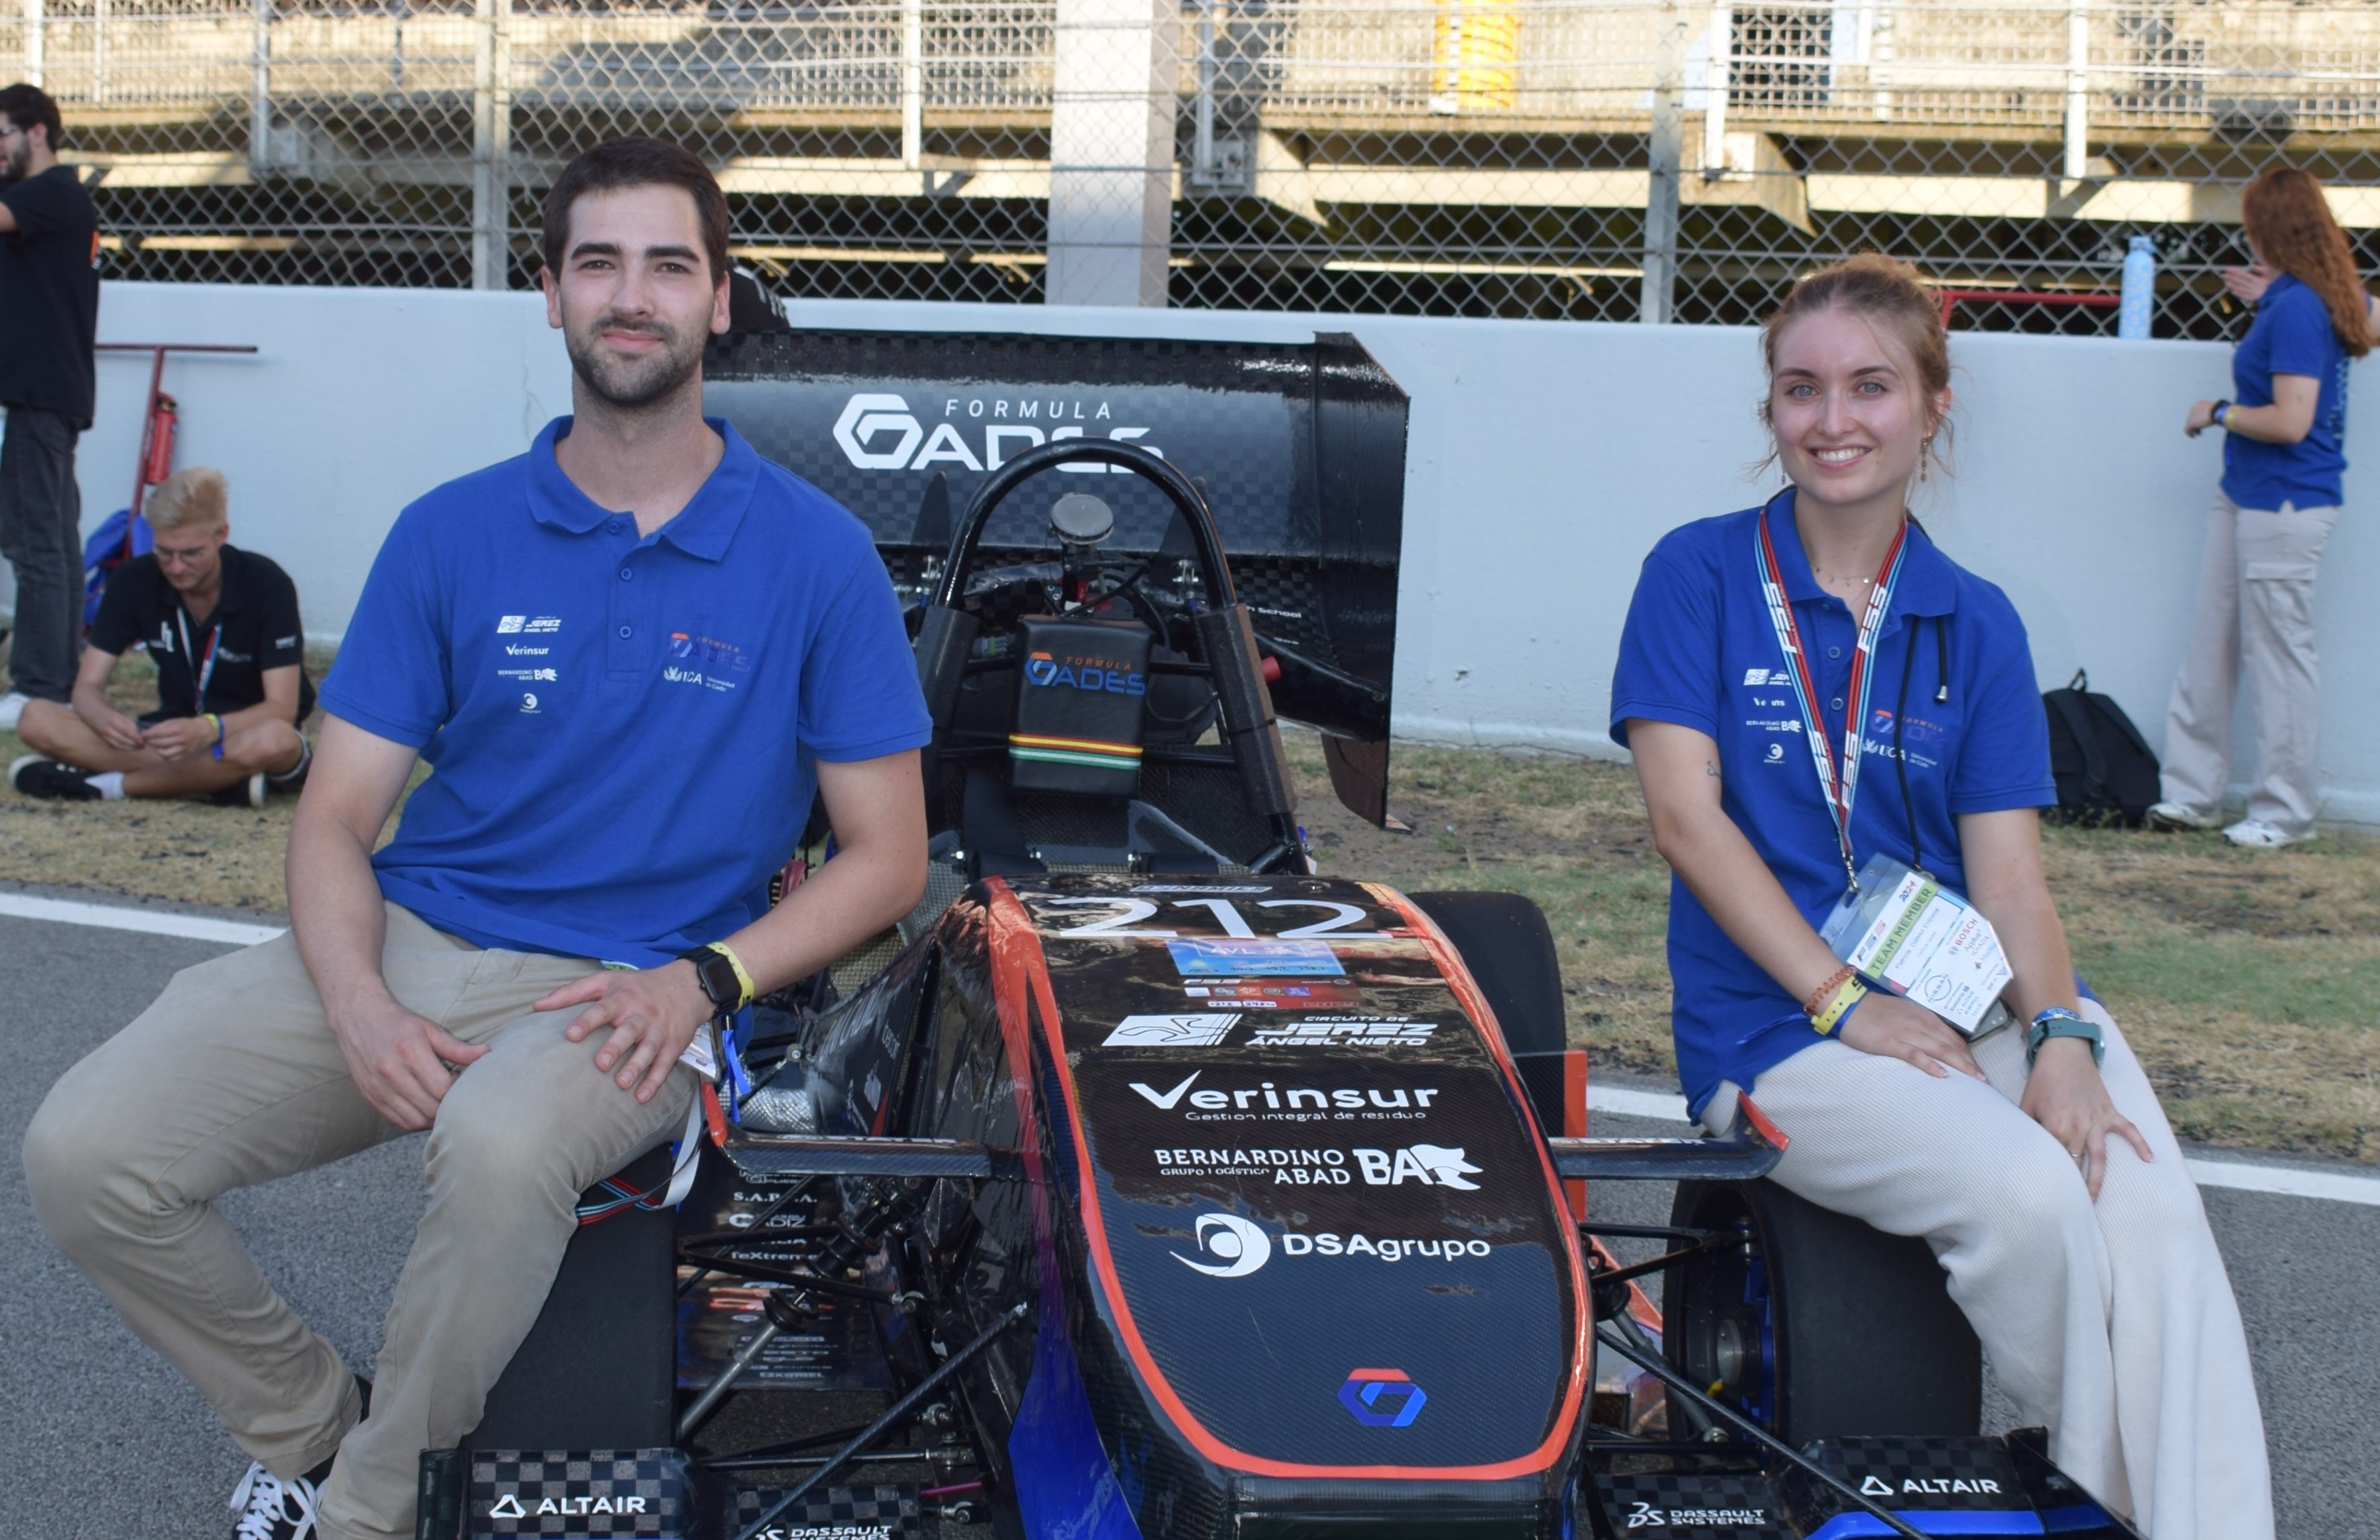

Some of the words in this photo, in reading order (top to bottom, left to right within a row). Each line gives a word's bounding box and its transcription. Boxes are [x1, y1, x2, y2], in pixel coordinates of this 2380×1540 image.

[945, 399, 1110, 419] FORMULA
[1258, 607, 1301, 618] School
[1856, 582, 1888, 654] FSS
[505, 643, 550, 655] Verinsur
[1065, 656, 1132, 671] FORMULA
[1898, 879, 1917, 903] 2024
[1048, 897, 1393, 939] 212
[1870, 937, 1898, 973] TEAM
[1894, 886, 1932, 938] MEMBER
[1955, 917, 1978, 947] BOSCH
[1927, 973, 1949, 1003] NISSAN
[1255, 1023, 1438, 1036] JEREZ
[1245, 1035, 1339, 1046] ÁNGEL
[1345, 1037, 1427, 1046] NIETO
[1128, 1068, 1439, 1110] Verinsur
[1262, 1112, 1328, 1122] integral
[1154, 1149, 1345, 1165] BERNARDINO
[1160, 1167, 1205, 1176] GRUPO
[1274, 1168, 1351, 1185] ABAD
[1282, 1233, 1491, 1262] DSAgrupo
[1902, 1478, 2001, 1494] ALTAIR
[536, 1496, 647, 1515] ALTAIR
[1670, 1509, 1764, 1518] DASSAULT
[791, 1525, 892, 1537] DASSAULT
